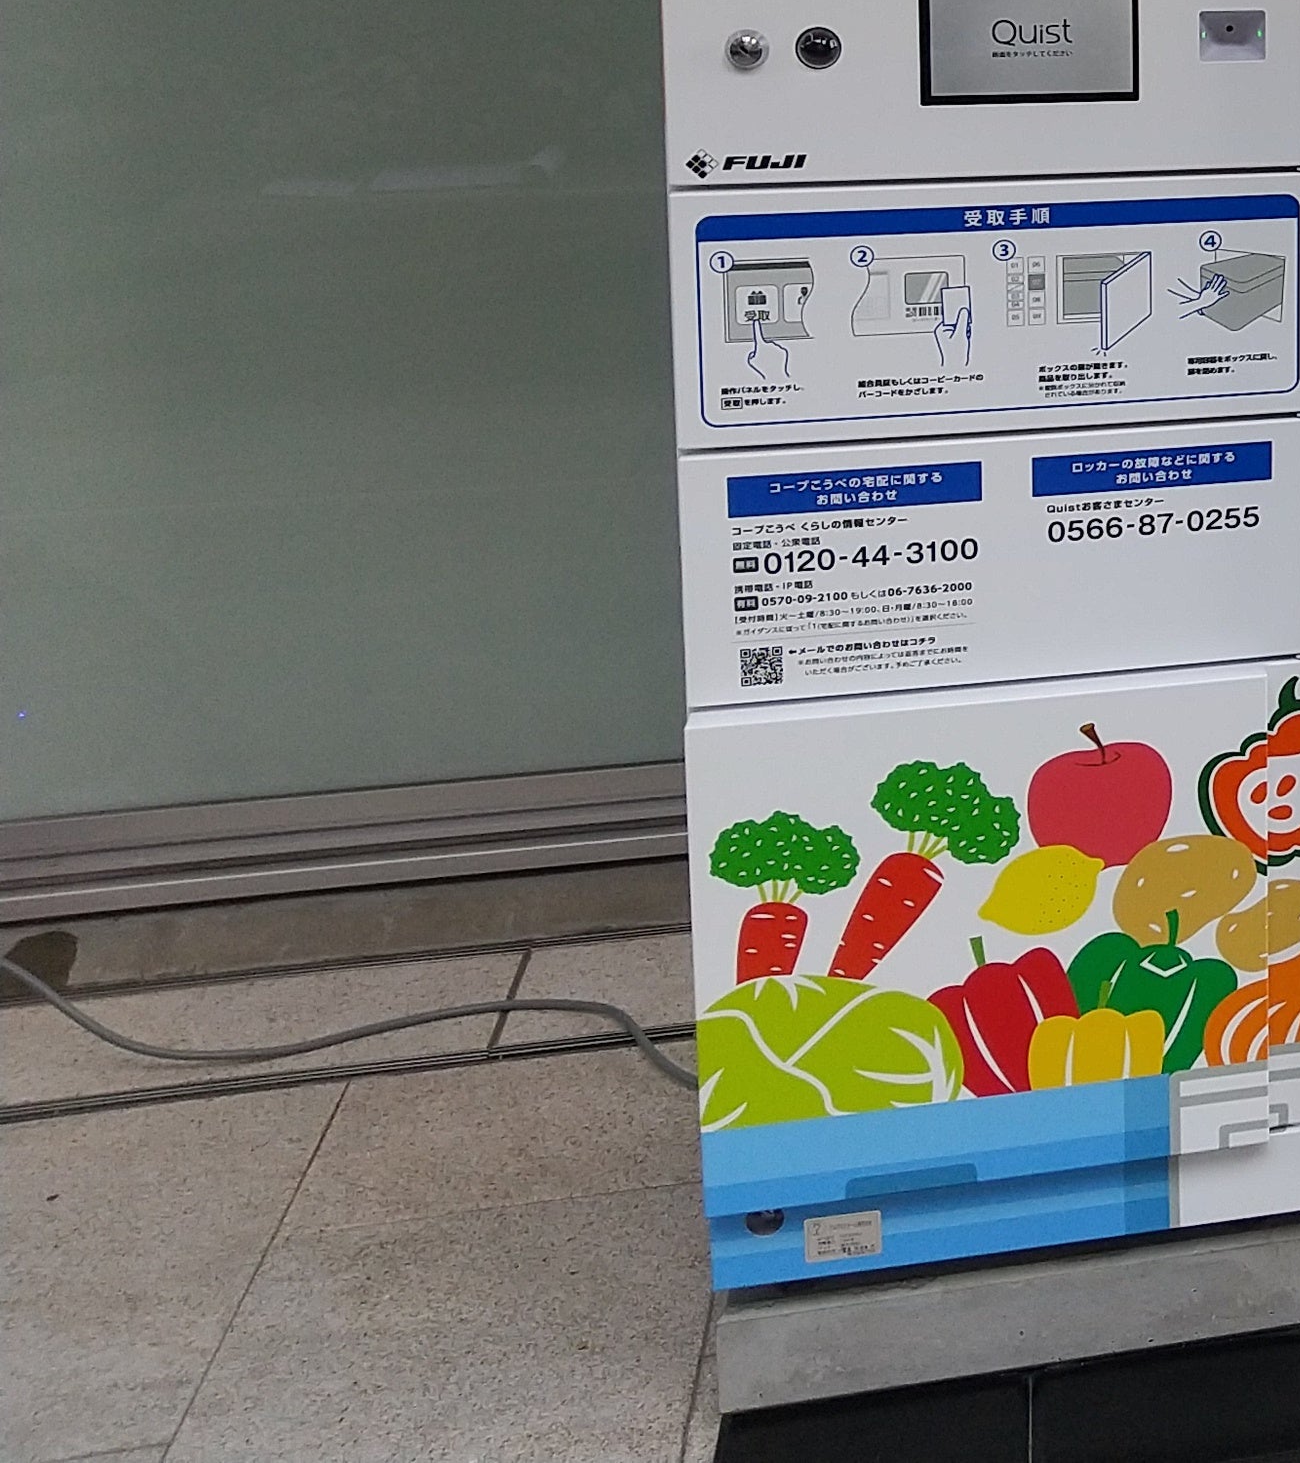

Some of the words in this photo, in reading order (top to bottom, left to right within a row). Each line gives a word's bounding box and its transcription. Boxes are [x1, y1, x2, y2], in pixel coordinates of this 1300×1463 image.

[992, 19, 1072, 46] Quist
[721, 152, 807, 171] FUJI
[963, 207, 1051, 228] 受取手順
[769, 472, 943, 494] コープこうべの宅配に関する
[1115, 468, 1193, 485] お問い合わせ
[816, 489, 898, 506] お問い合わせ
[1047, 506, 1260, 543] 0566-87-0255
[764, 537, 979, 575] 0120-44-3100
